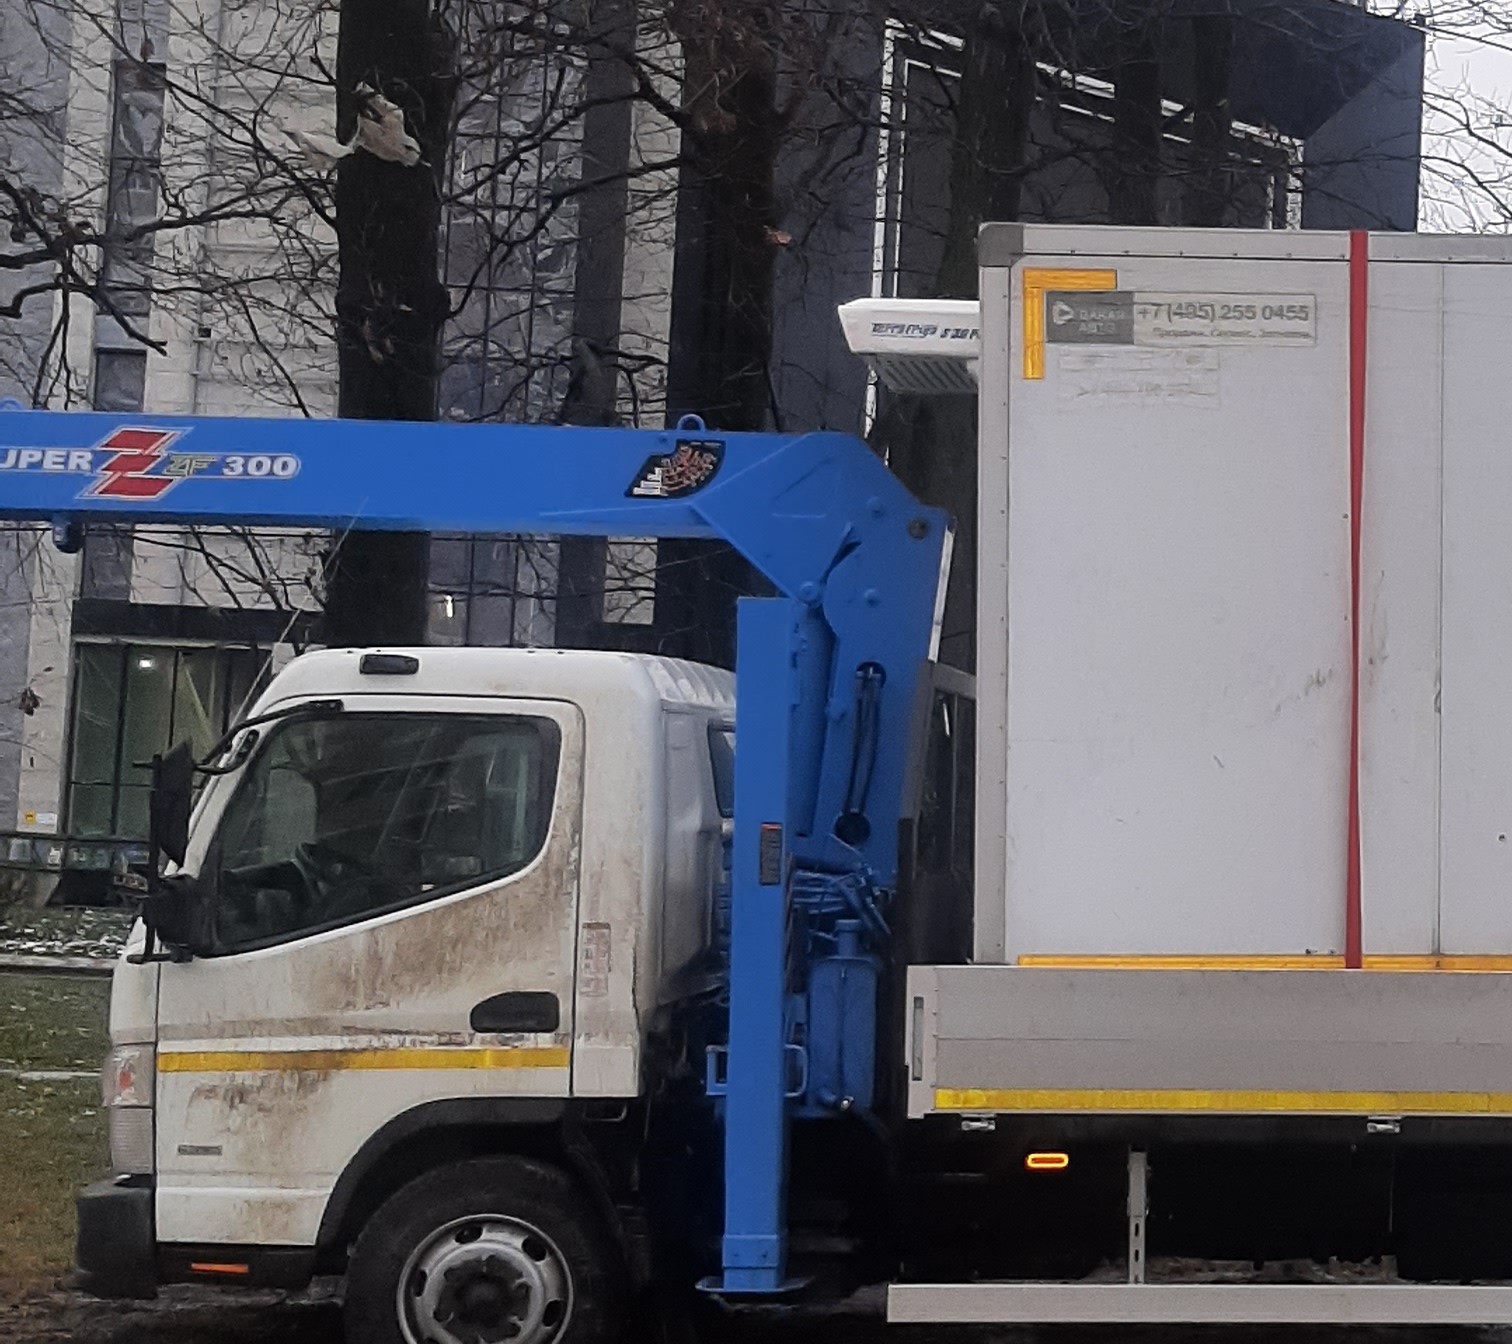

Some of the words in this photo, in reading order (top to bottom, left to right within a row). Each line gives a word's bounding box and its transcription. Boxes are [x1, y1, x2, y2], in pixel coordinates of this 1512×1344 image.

[1219, 305, 1257, 321] 255
[1262, 305, 1309, 321] 0455
[221, 455, 297, 477] 300
